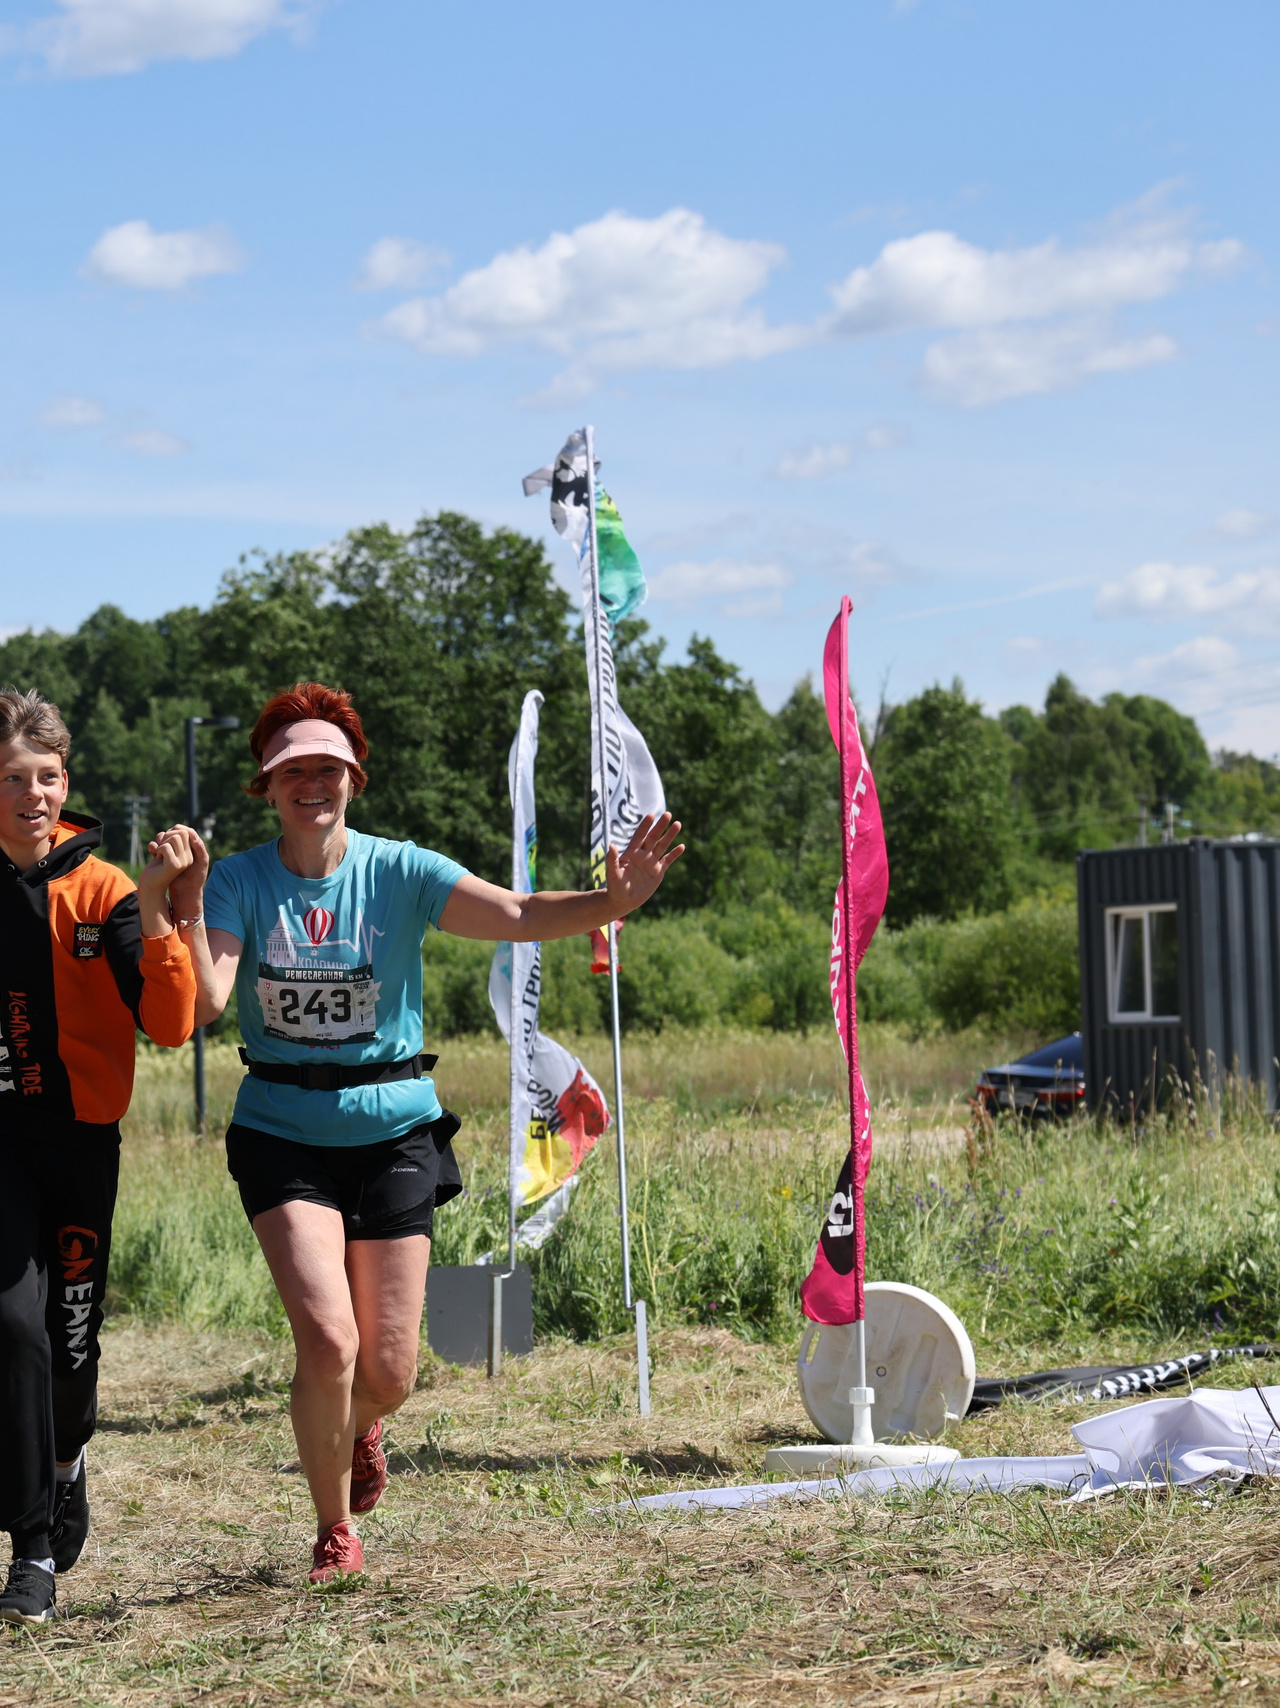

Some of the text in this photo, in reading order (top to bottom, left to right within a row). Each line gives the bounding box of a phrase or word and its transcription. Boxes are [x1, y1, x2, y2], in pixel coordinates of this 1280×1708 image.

[78, 926, 100, 934] EVERY
[76, 933, 100, 942] THING
[285, 970, 344, 981] РЕМЕСЛЕННАЯ
[279, 988, 351, 1025] 243
[19, 1062, 42, 1097] TIDE
